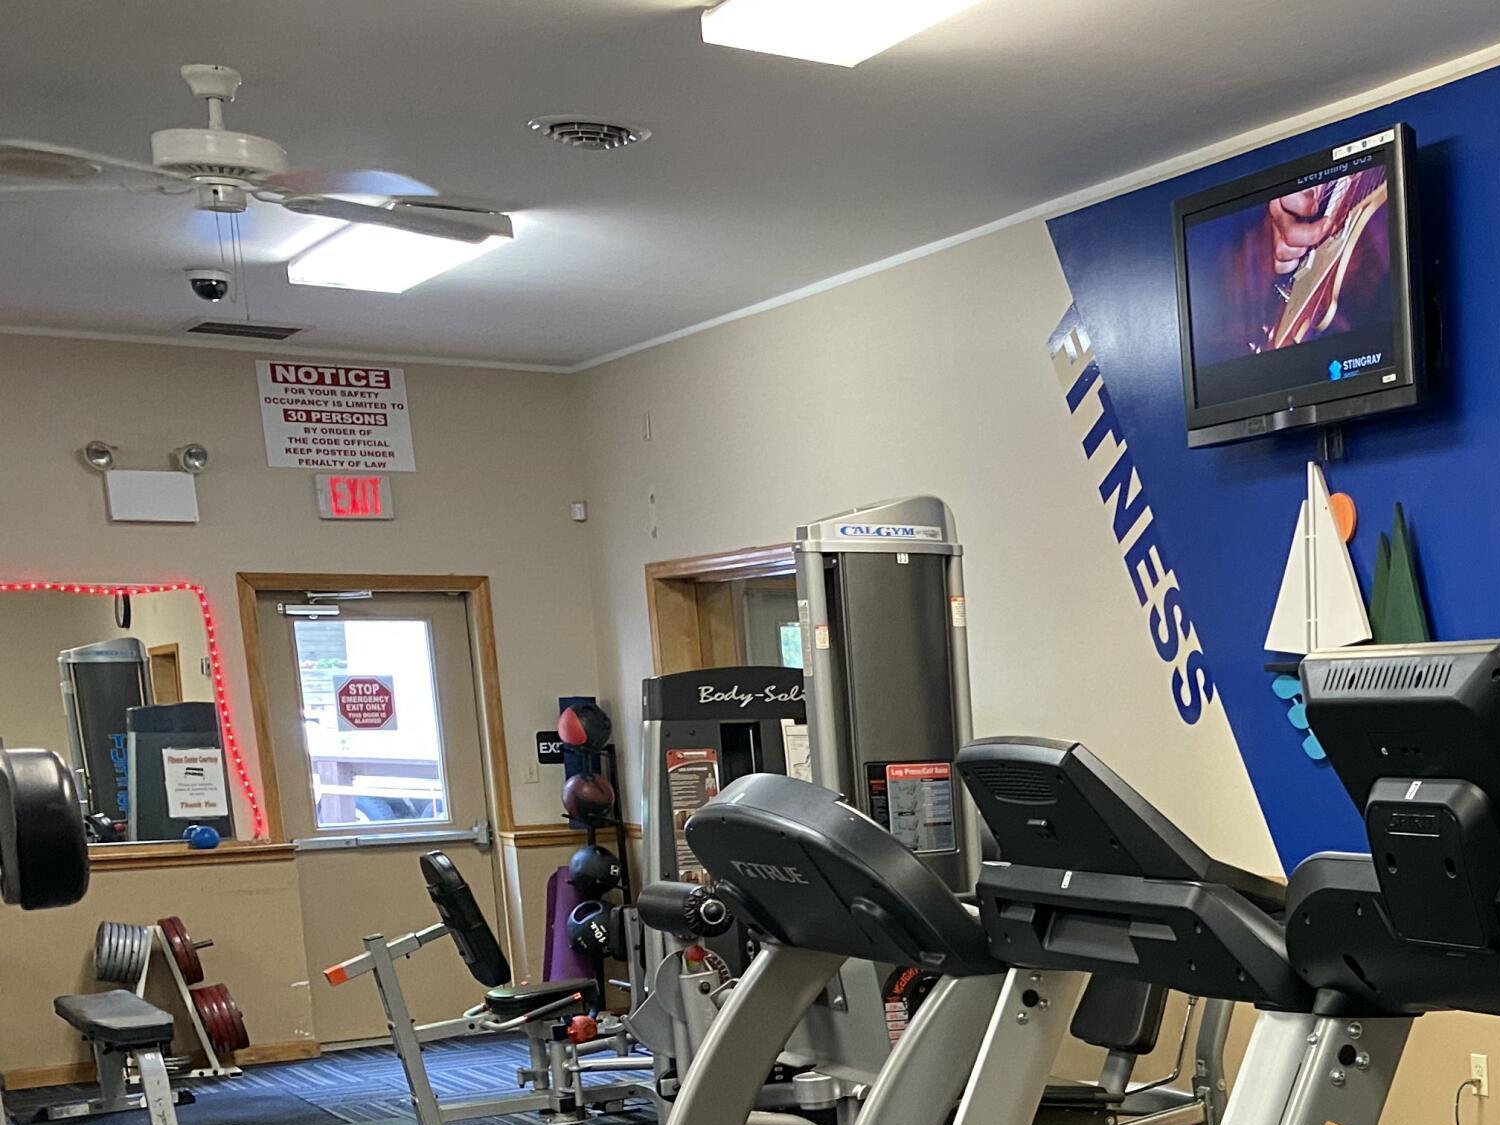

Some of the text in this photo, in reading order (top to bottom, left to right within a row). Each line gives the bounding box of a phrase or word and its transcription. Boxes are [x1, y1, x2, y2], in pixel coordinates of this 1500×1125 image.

[1342, 352, 1382, 371] STINGRAY
[274, 365, 387, 388] NOTICE
[284, 387, 379, 399] FOR YOUR SAFETY
[264, 397, 405, 410] OCCUPANCY IS LIMITED TO
[287, 410, 386, 426] 30 PERSONS
[320, 427, 357, 436] ORDER
[358, 429, 373, 437] OF
[287, 436, 390, 448] THE CODE OFFICIAL
[284, 447, 395, 458] KEEP POSTED UNDER
[298, 458, 387, 469] PENALTY OF LAW
[329, 475, 382, 516] EXIT
[1046, 302, 1214, 725] FITNESS
[348, 683, 380, 695] STOP
[341, 695, 390, 703] EMERGENCY
[698, 685, 806, 708] Body-Soli
[345, 703, 386, 712] EXIT ONLY
